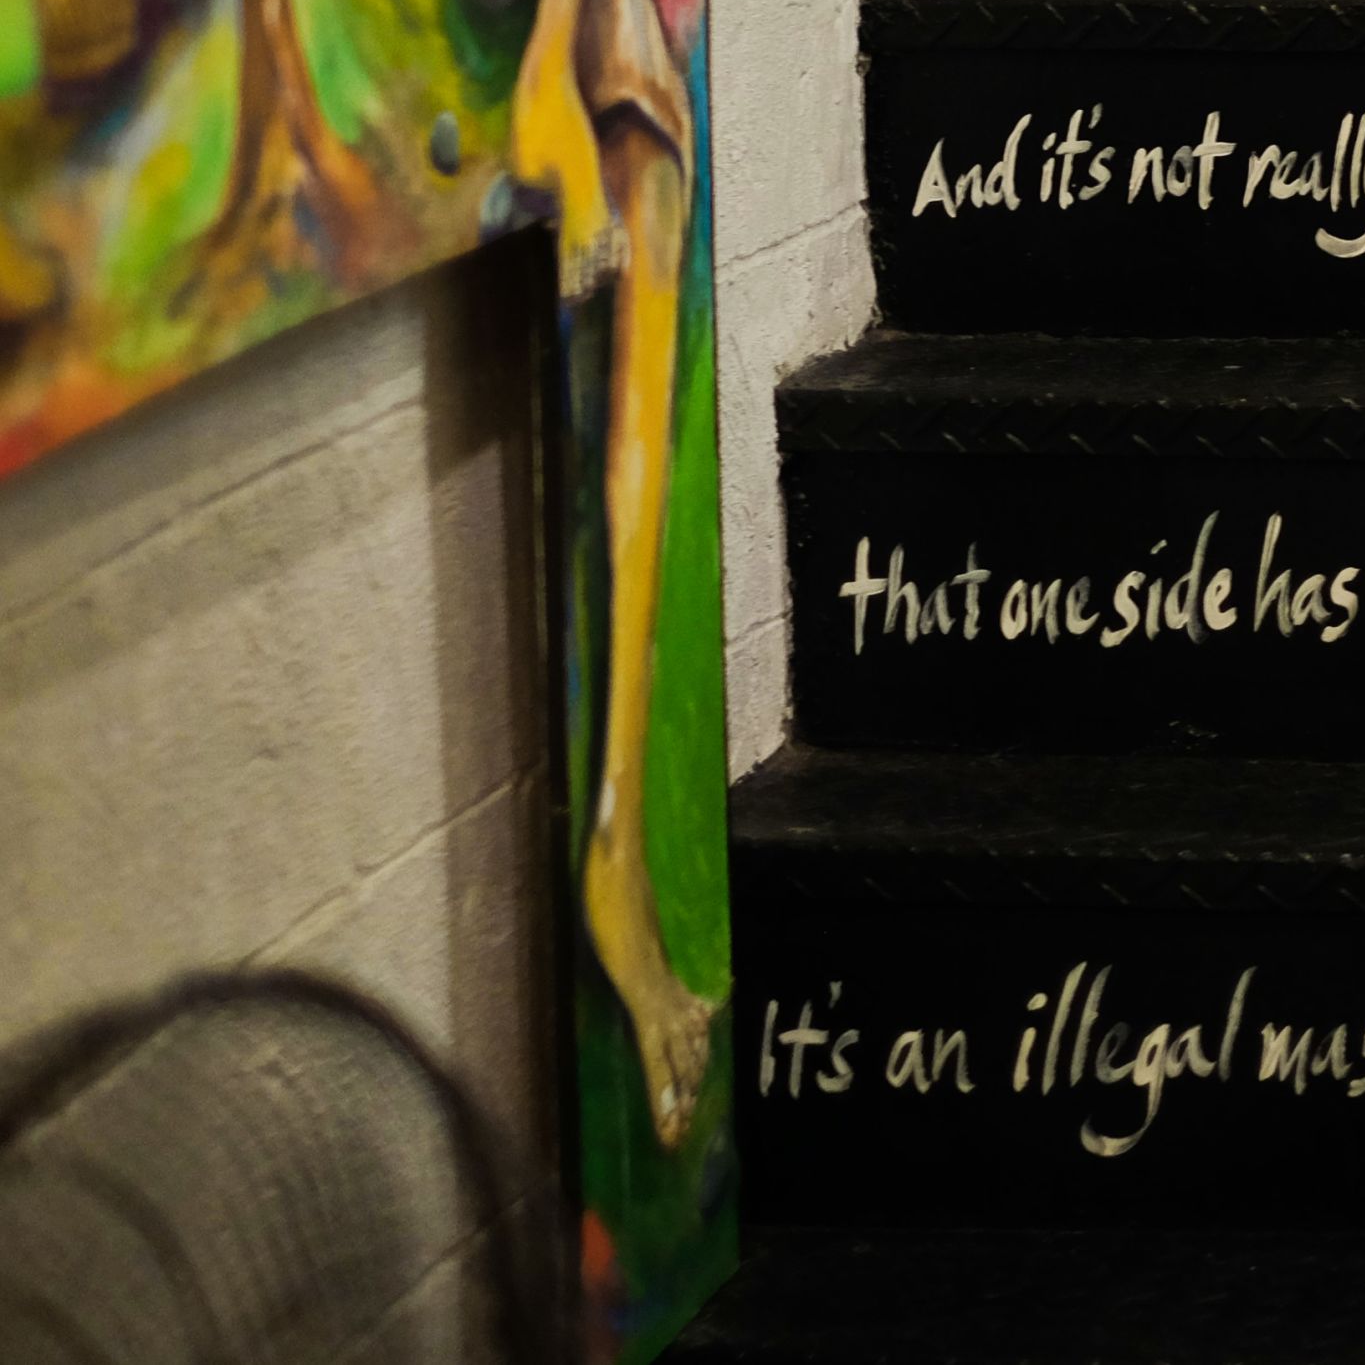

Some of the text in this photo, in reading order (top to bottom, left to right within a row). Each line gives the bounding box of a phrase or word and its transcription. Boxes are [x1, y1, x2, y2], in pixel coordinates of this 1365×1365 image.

[911, 112, 1034, 219] And
[1039, 103, 1116, 210] it's
[1127, 110, 1237, 211] not
[838, 535, 993, 656] that
[1000, 575, 1101, 645] one
[1101, 510, 1239, 648] side
[1253, 510, 1362, 644] has
[759, 980, 861, 1100] It's
[885, 1029, 976, 1094] an
[1012, 961, 1258, 1157] illegal
